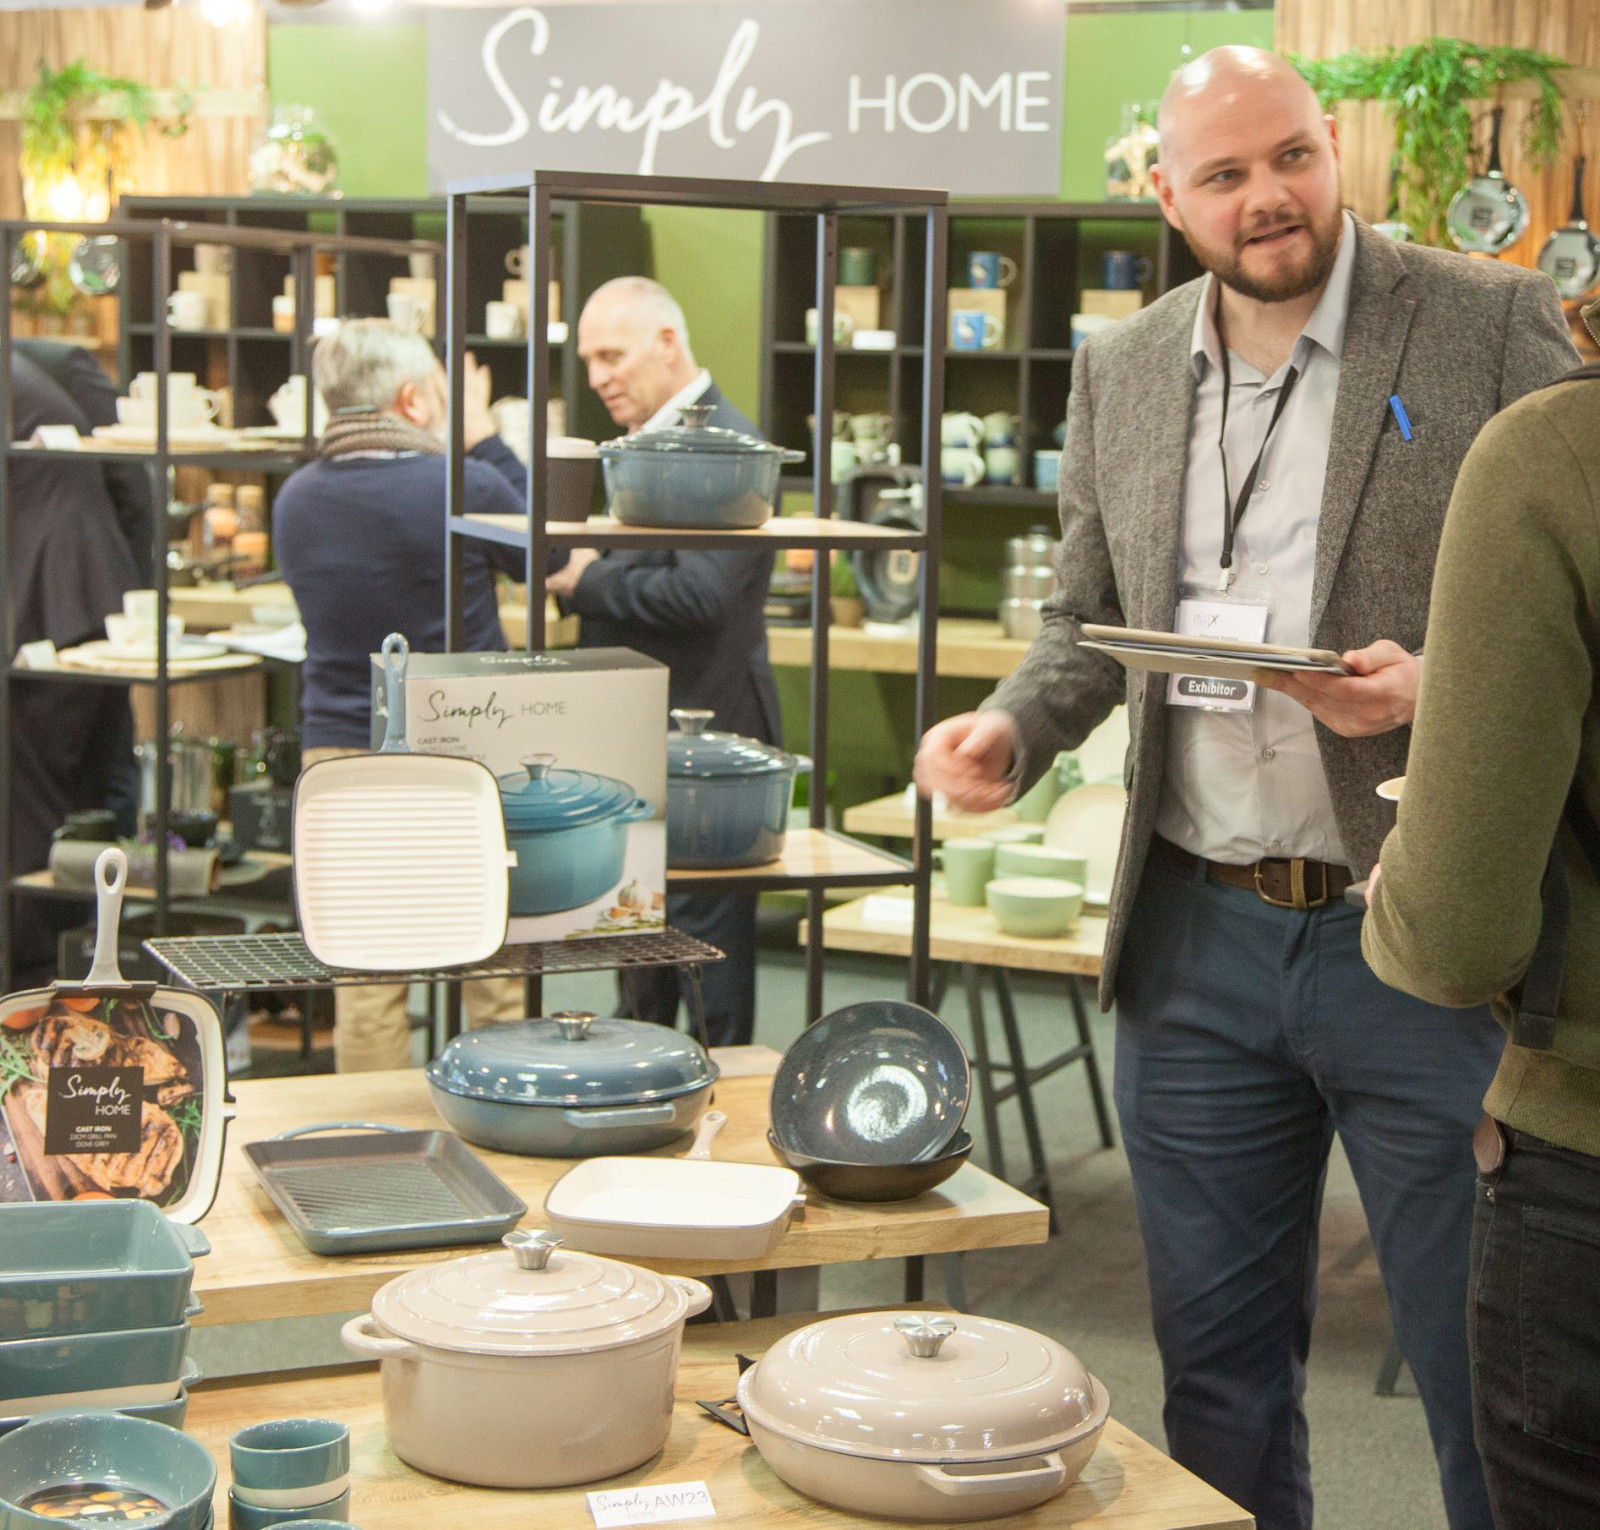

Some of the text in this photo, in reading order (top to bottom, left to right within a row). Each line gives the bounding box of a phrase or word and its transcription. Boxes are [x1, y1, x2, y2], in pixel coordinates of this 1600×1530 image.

[437, 8, 1051, 180] Simply HOME
[1188, 680, 1237, 696] Exhibitor
[417, 690, 514, 728] Simply
[521, 701, 567, 715] HOME
[417, 736, 460, 745] CAST IRON
[59, 1074, 133, 1105] Simply
[95, 1104, 131, 1116] HOME
[75, 1125, 94, 1133] CAST
[596, 1490, 710, 1512] Simply AW23
